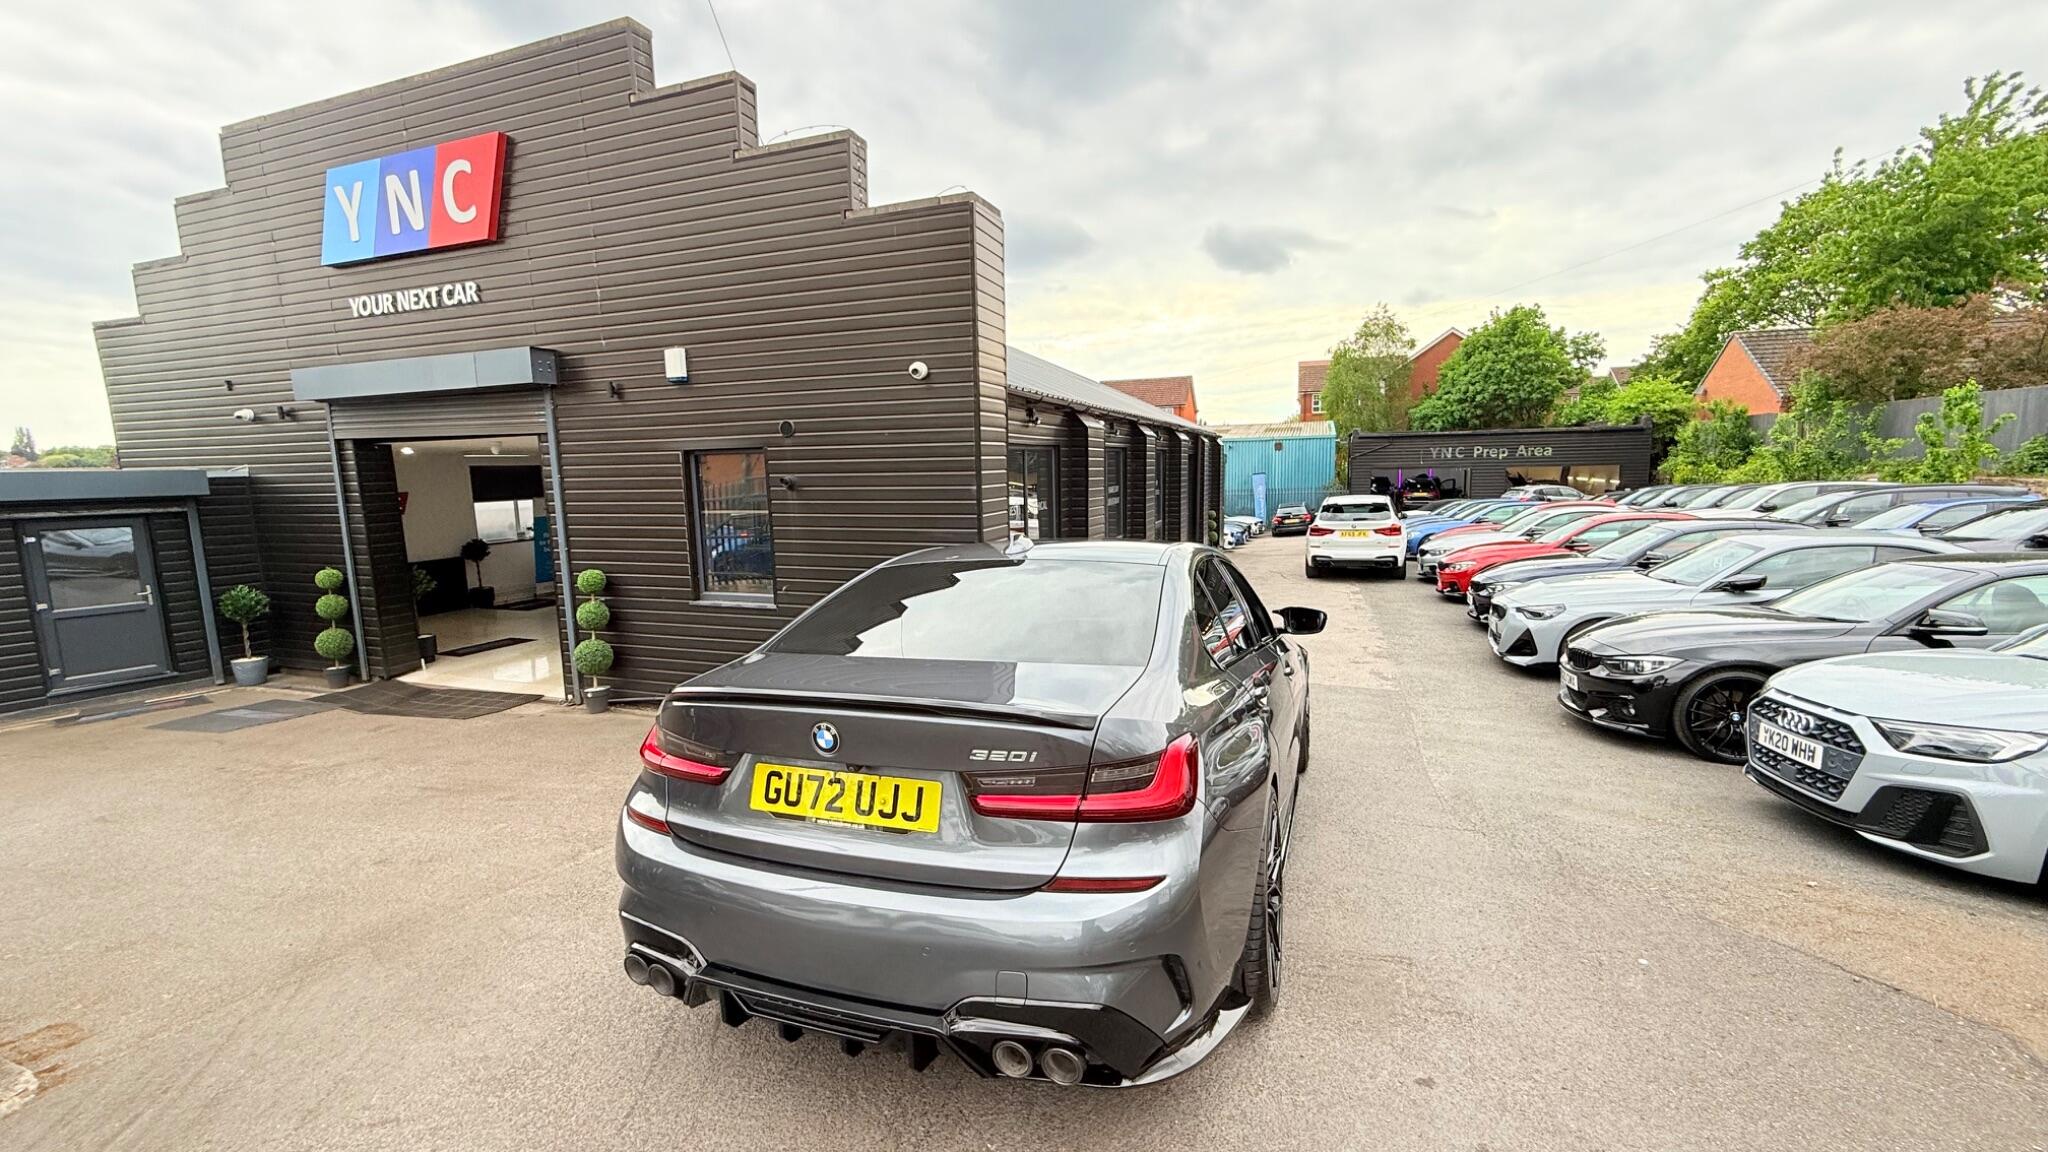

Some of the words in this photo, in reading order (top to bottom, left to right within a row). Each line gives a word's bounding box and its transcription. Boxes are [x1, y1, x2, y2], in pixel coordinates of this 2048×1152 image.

[333, 159, 477, 242] YNC
[349, 293, 395, 318] YOUR
[396, 286, 439, 311] NEXT
[442, 281, 479, 305] CAR
[1430, 446, 1465, 459] YNC
[1473, 446, 1509, 459] Prep
[1515, 444, 1553, 457] Area
[969, 749, 1038, 762] 320i
[764, 770, 845, 813] GU72
[855, 780, 924, 823] UJJ
